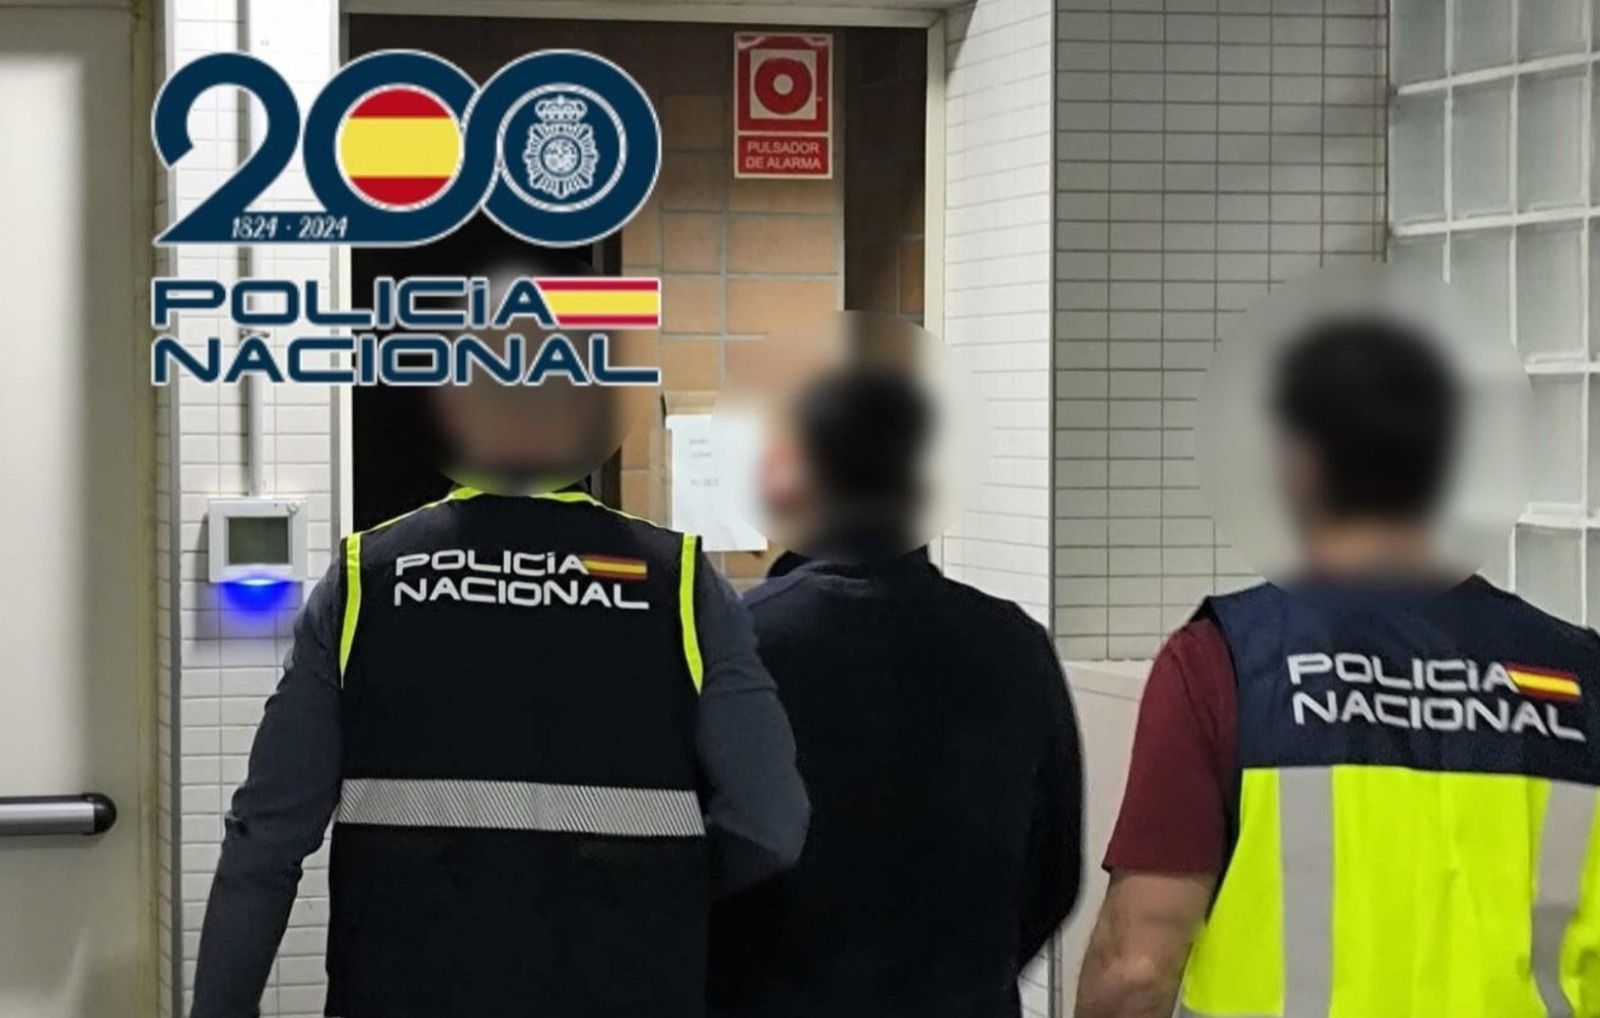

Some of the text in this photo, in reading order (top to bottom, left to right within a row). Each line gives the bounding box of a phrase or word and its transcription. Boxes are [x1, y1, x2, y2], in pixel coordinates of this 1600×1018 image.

[747, 141, 820, 154] PULSADOR
[745, 156, 822, 169] DE ALARMA
[394, 576, 650, 610] NACIONAL
[1293, 690, 1586, 742] NACIONAL
